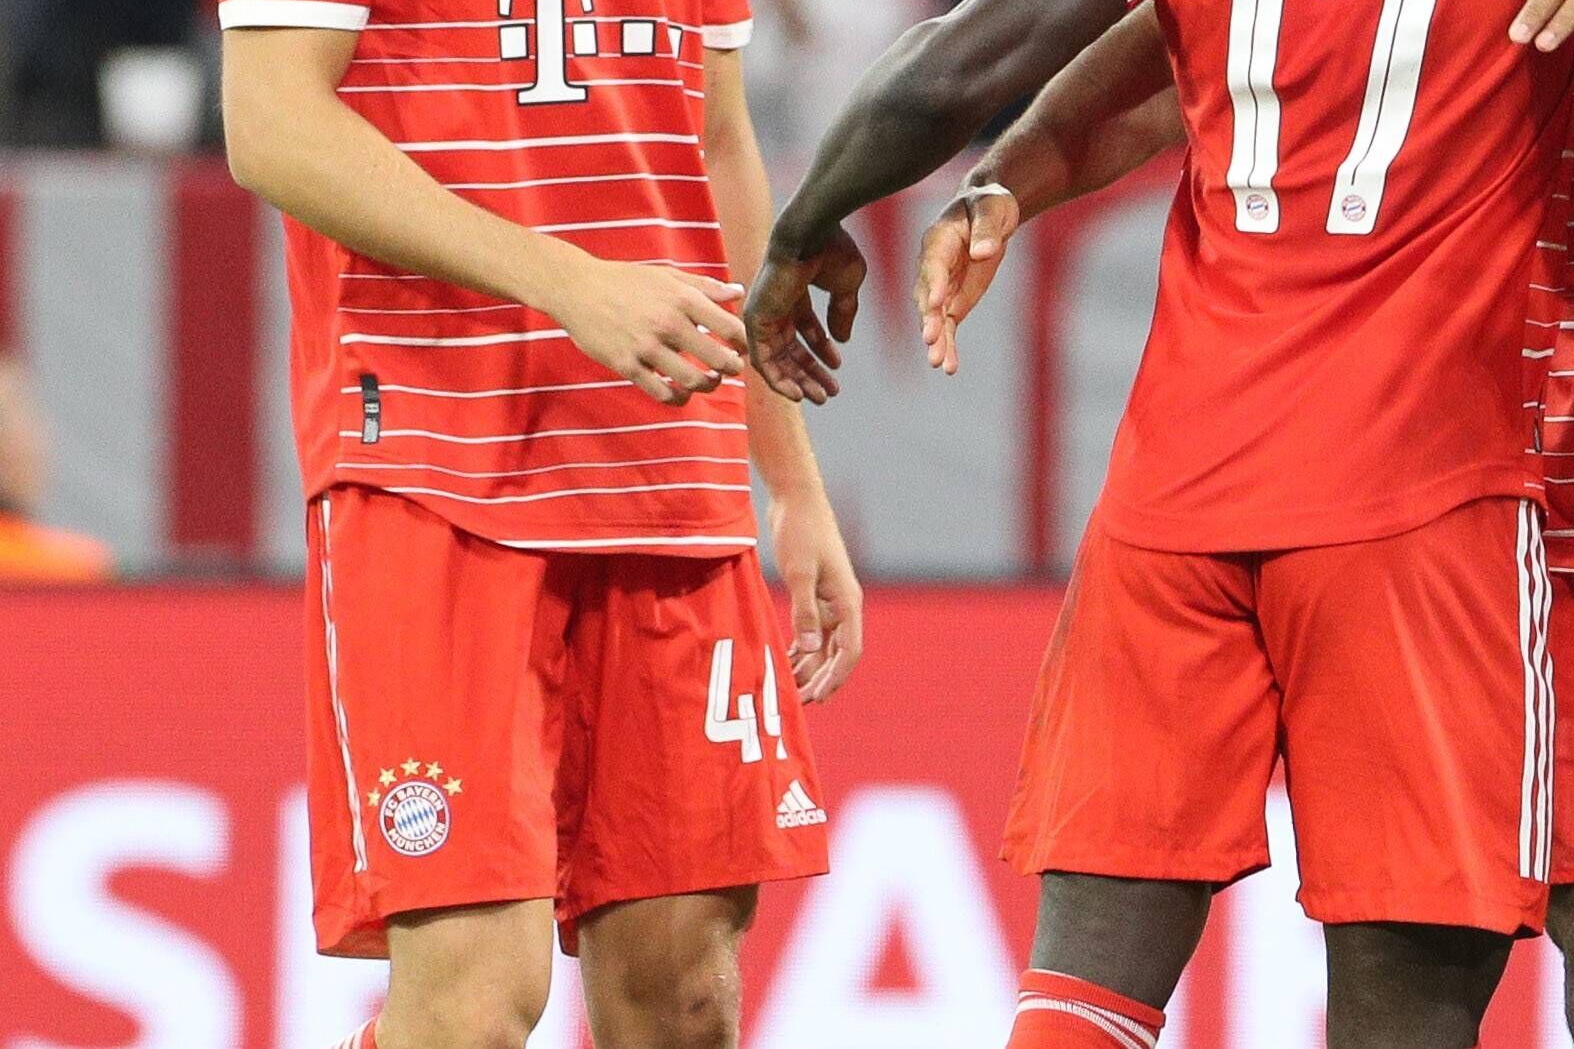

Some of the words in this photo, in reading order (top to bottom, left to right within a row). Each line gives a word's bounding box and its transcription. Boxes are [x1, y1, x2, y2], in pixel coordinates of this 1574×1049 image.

[396, 785, 445, 811] BAYERN
[775, 807, 829, 830] adidas
[387, 821, 446, 852] MÜNCHEN
